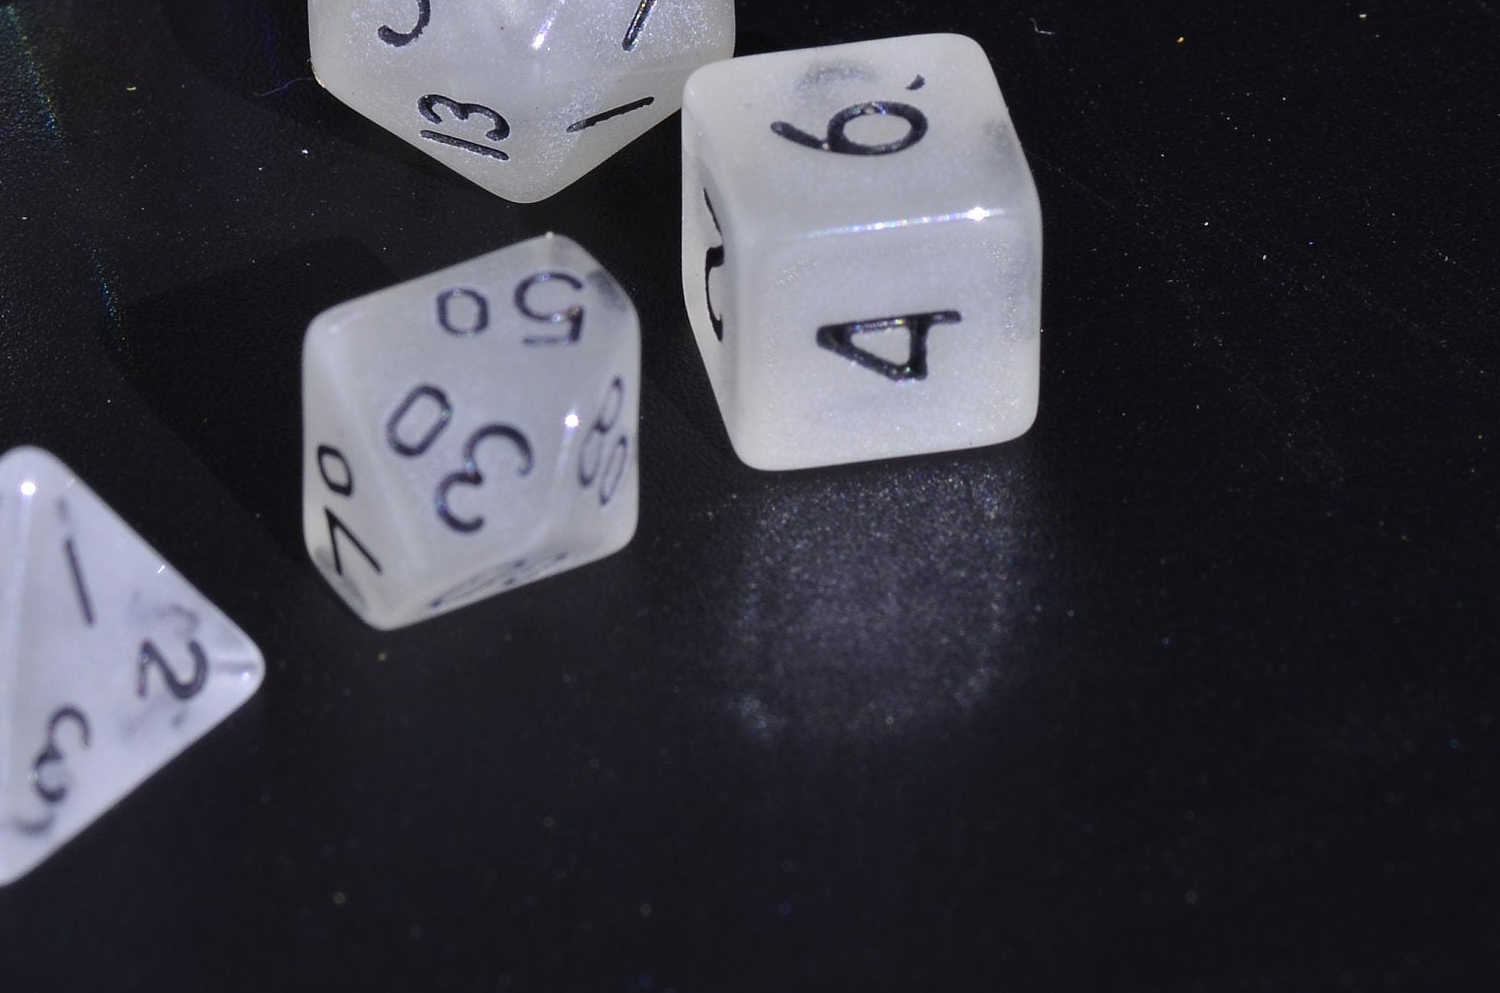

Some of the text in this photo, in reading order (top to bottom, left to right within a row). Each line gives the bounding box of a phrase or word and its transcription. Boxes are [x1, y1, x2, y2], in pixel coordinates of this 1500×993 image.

[417, 93, 510, 160] 13
[566, 96, 655, 133] 1
[815, 310, 963, 382] 4
[64, 536, 95, 626] 1
[136, 639, 209, 701] 2
[30, 705, 93, 804] 3
